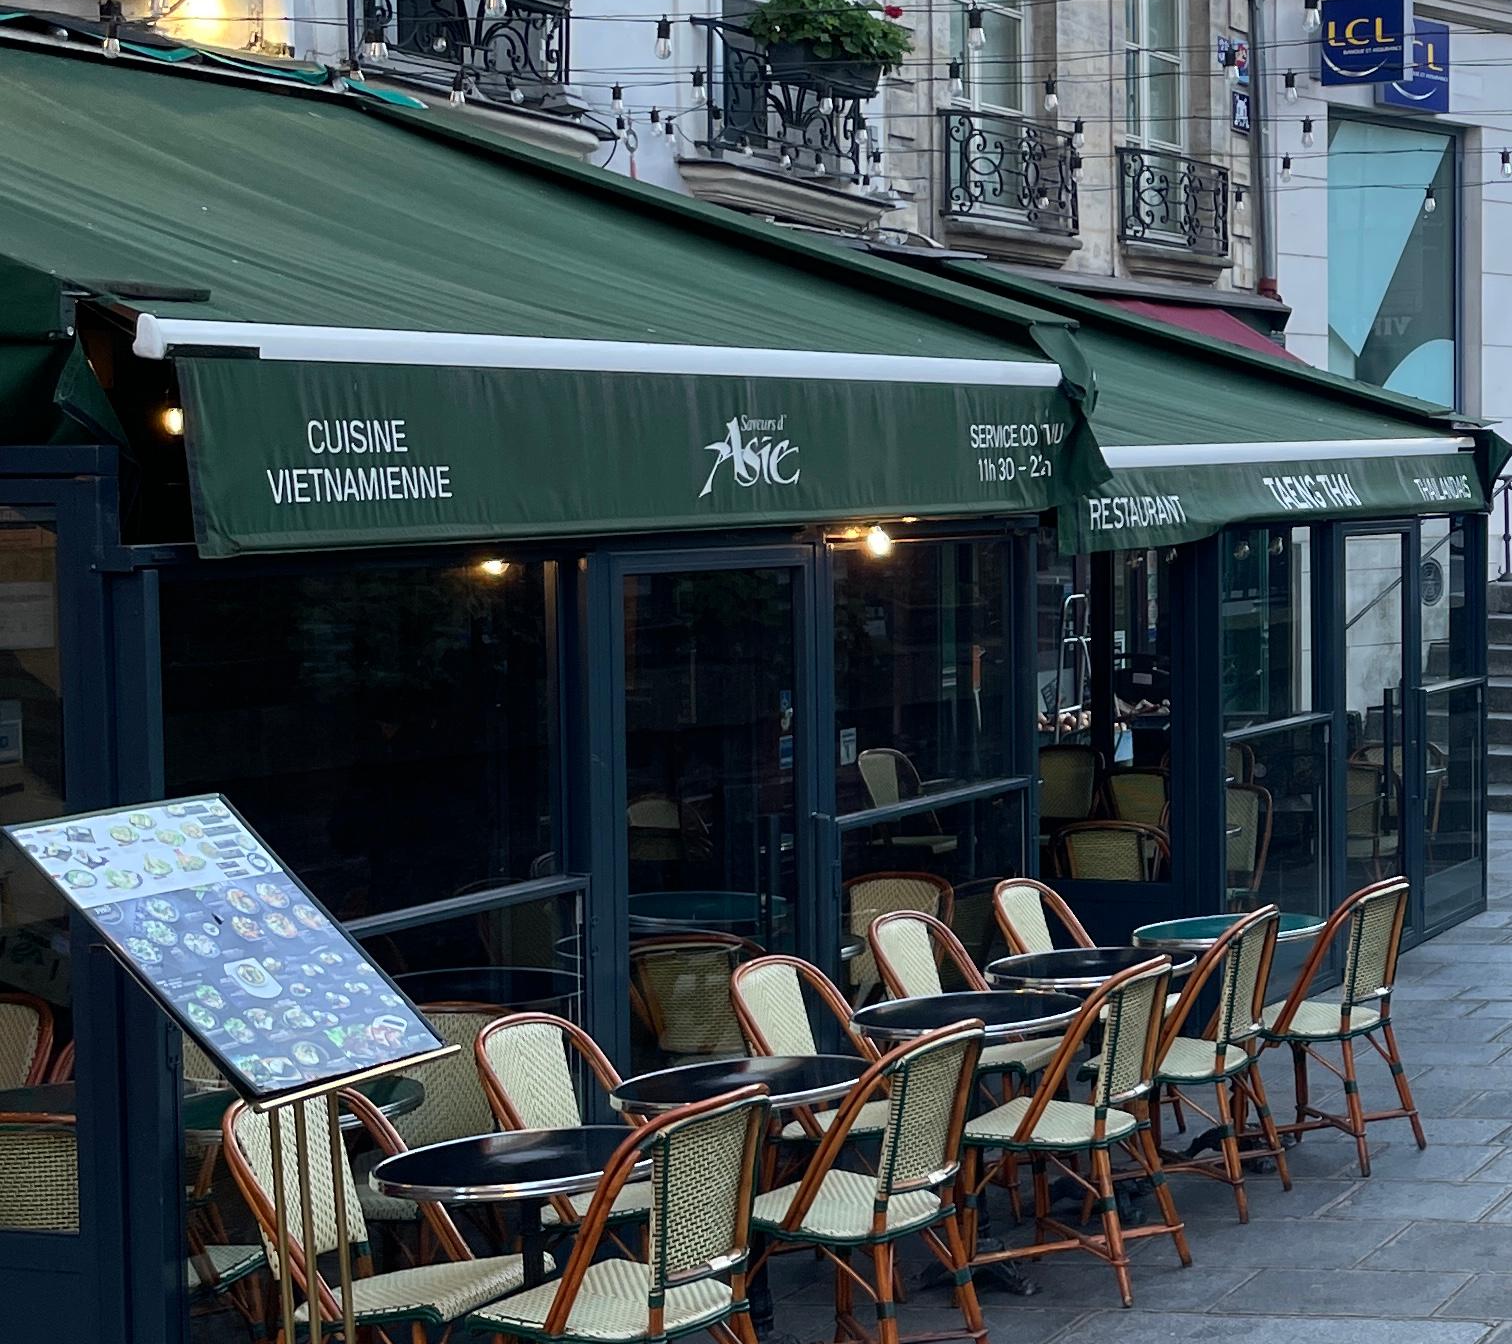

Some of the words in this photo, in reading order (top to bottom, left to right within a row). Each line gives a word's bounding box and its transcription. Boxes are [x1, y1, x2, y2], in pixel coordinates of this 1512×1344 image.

[1328, 17, 1395, 46] LCL
[307, 419, 408, 454] CUISINE
[970, 424, 1019, 449] SERVICE
[698, 417, 801, 498] Asie
[978, 457, 997, 482] 11h
[998, 457, 1015, 481] 30
[266, 465, 453, 504] VIETNAMIENNE
[1088, 495, 1187, 531] RESTAURANT
